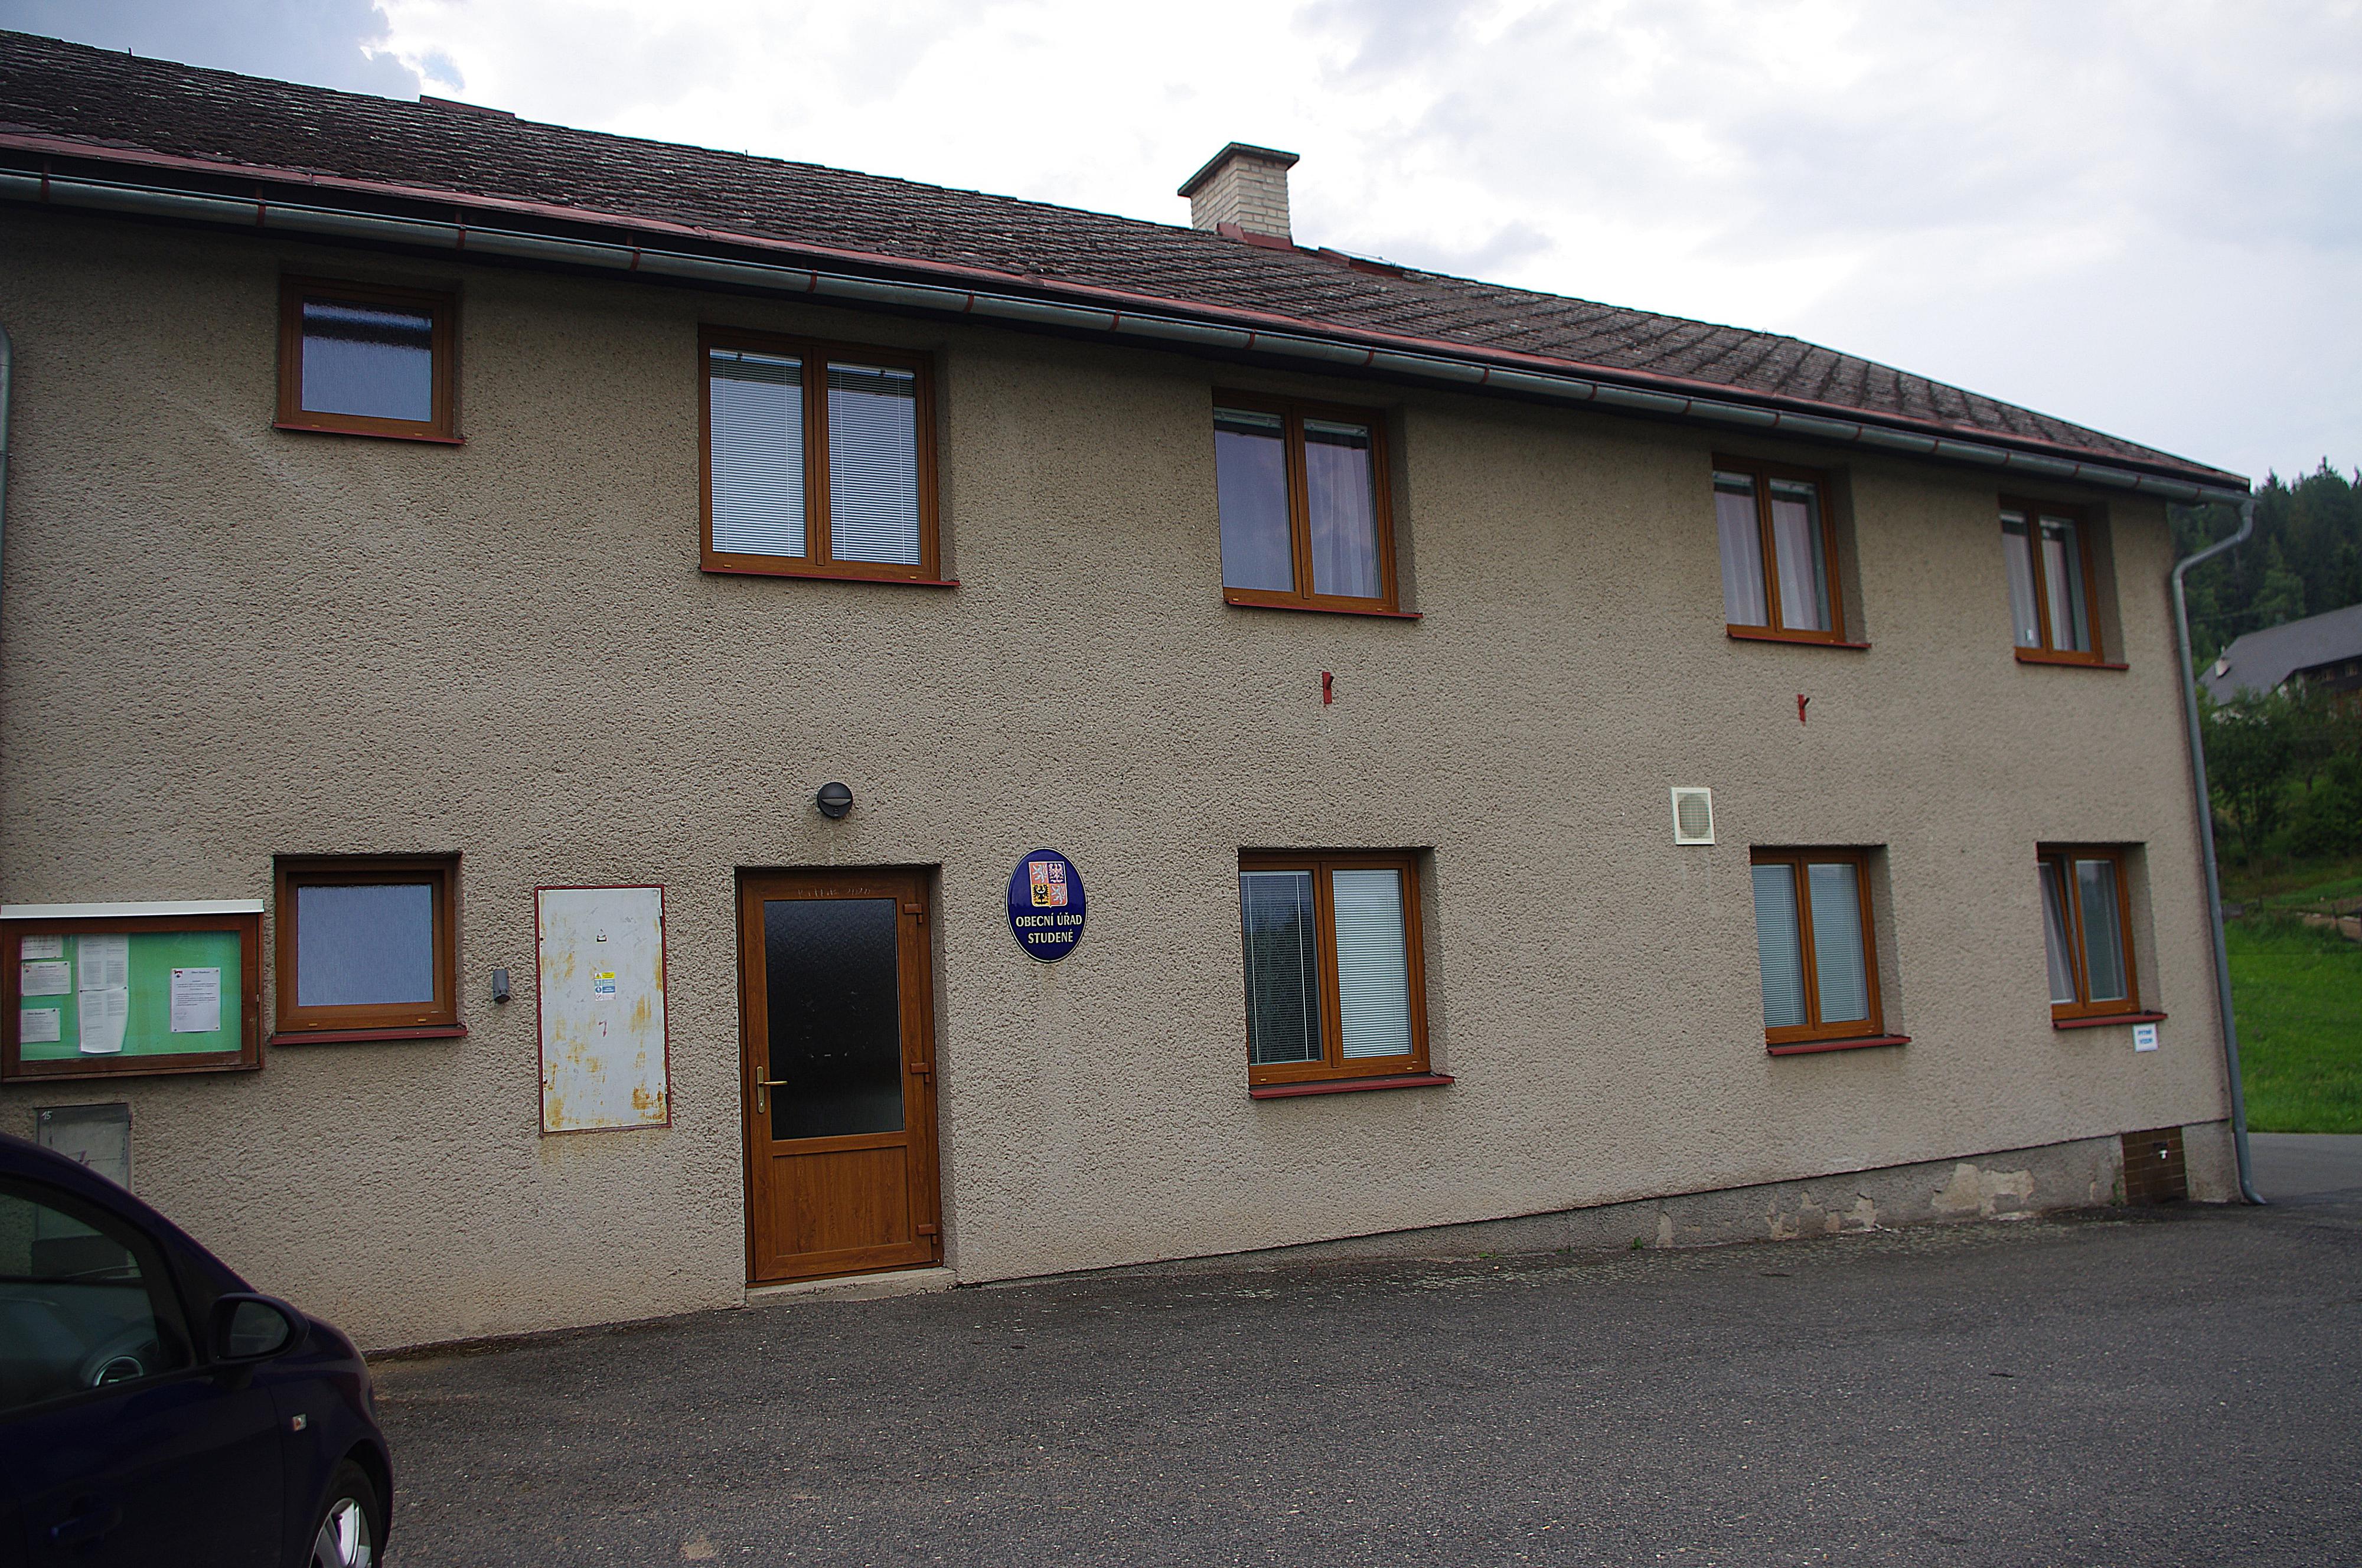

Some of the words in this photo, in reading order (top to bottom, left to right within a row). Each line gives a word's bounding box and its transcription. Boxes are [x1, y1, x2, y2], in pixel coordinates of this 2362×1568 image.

[1016, 913, 1054, 927] OBECNÍ
[1056, 912, 1082, 926] ÚŘAD
[1028, 929, 1074, 943] STUDENÉ
